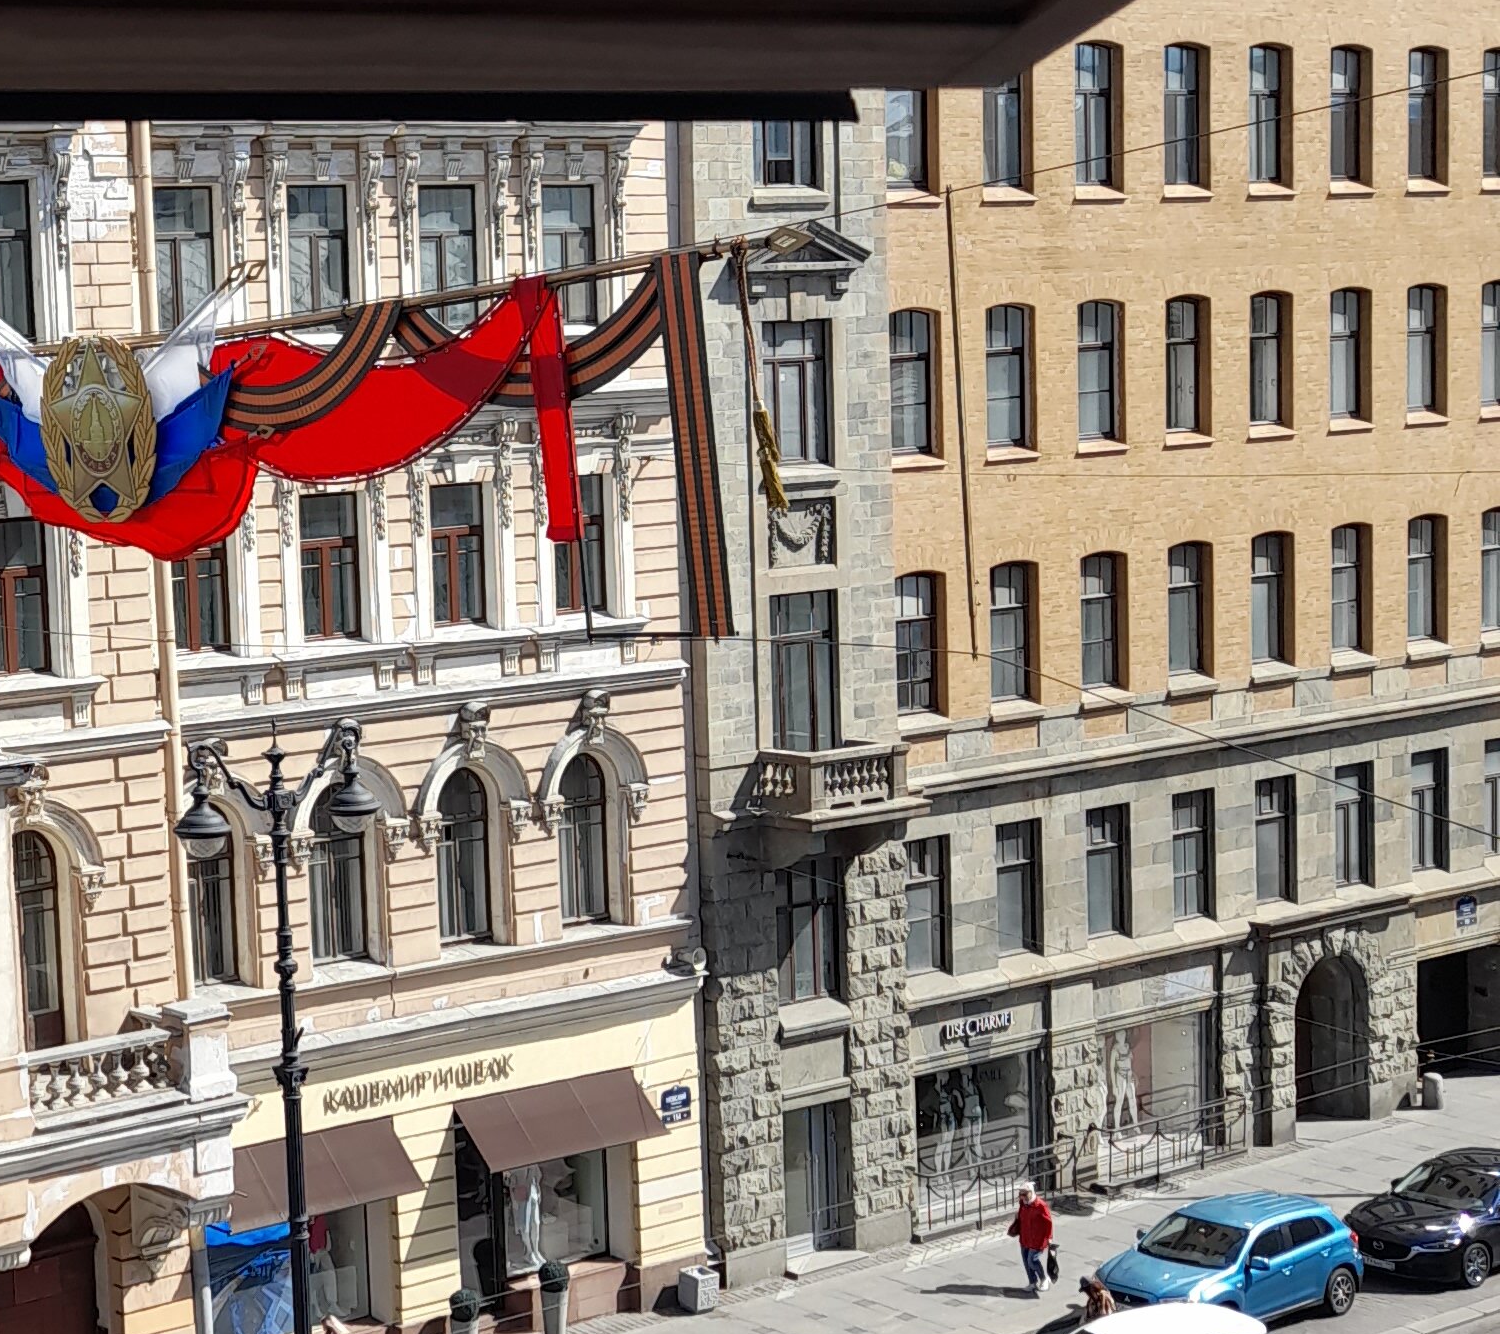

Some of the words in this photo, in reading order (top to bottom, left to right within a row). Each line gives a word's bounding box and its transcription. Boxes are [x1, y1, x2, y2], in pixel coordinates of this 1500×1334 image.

[946, 1022, 965, 1040] LISE
[965, 1011, 1016, 1037] CHARMEL
[324, 1070, 432, 1114] КАШЕМИР
